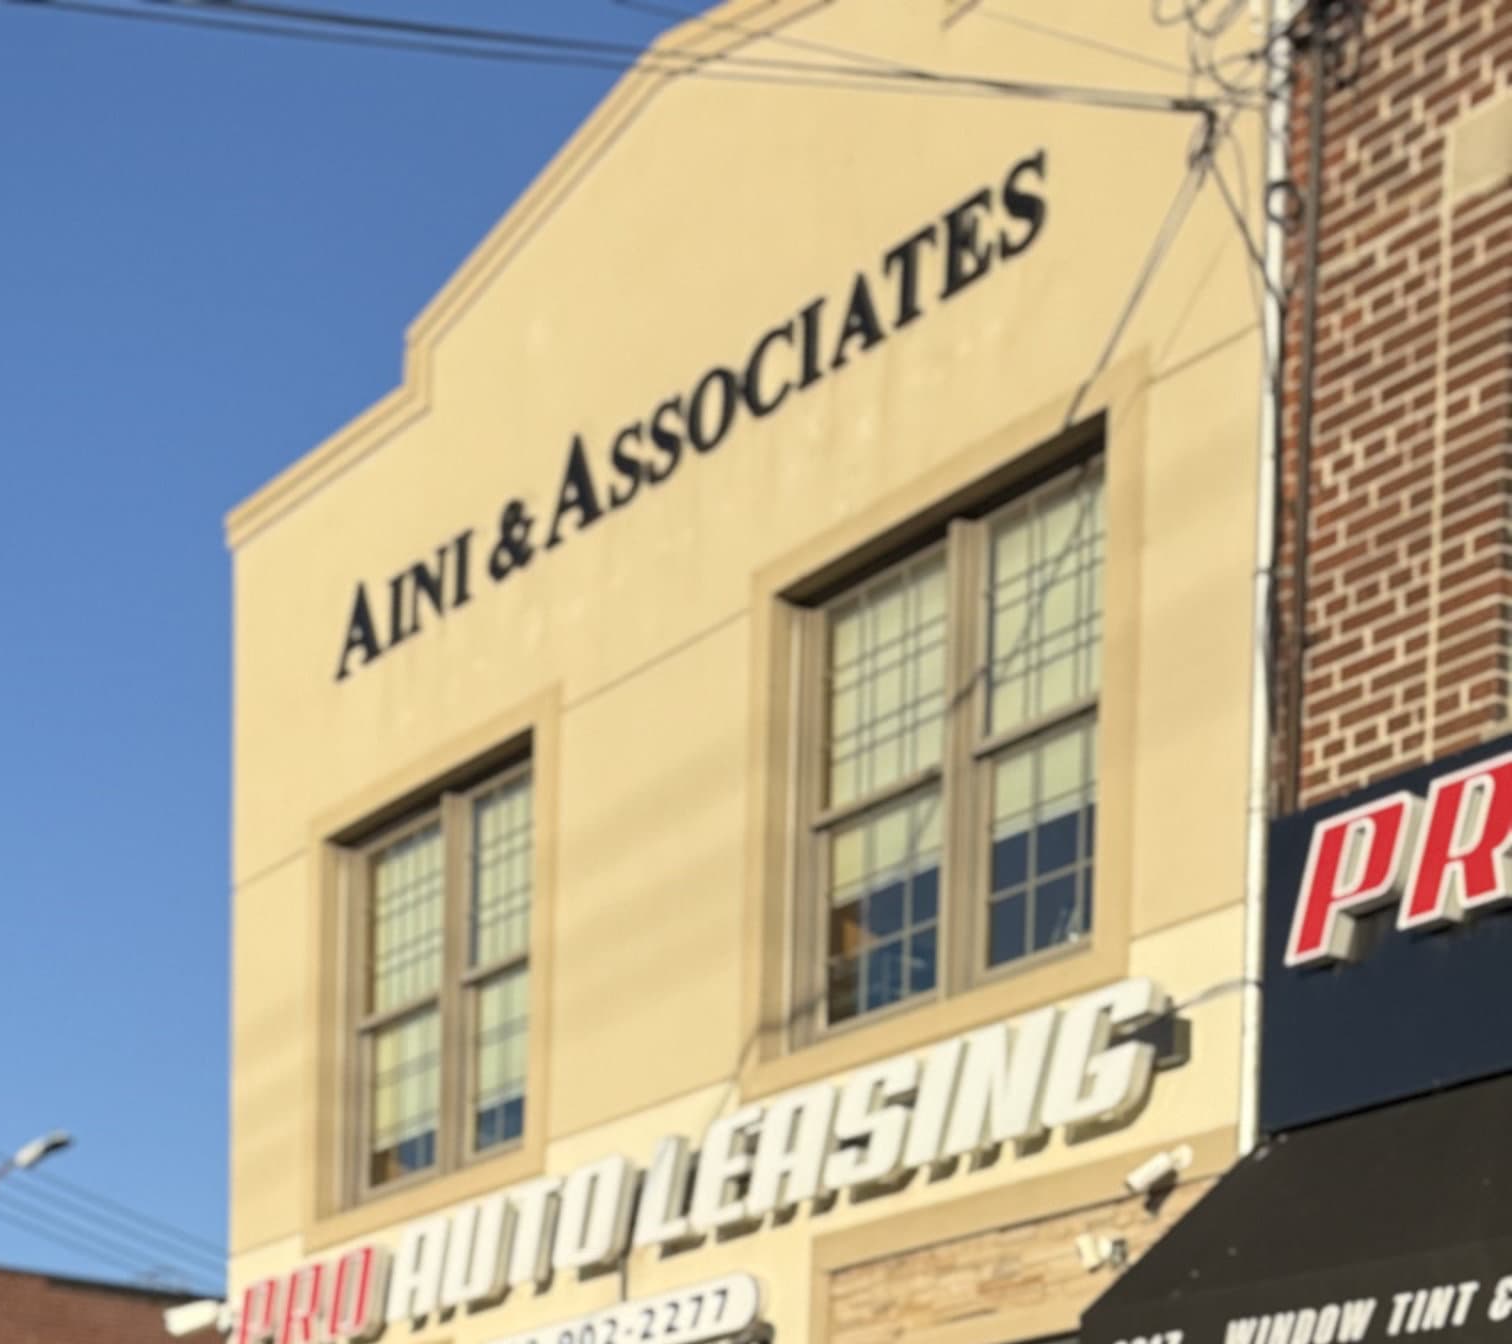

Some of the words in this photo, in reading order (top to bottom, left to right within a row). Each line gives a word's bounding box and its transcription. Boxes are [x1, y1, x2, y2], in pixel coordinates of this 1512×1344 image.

[335, 529, 475, 682] AINI
[488, 500, 537, 582] &
[545, 150, 1048, 552] ASSOCIATES
[387, 1154, 632, 1325] AUTO
[634, 978, 1160, 1250] LEASING
[1387, 1281, 1480, 1337] TINT
